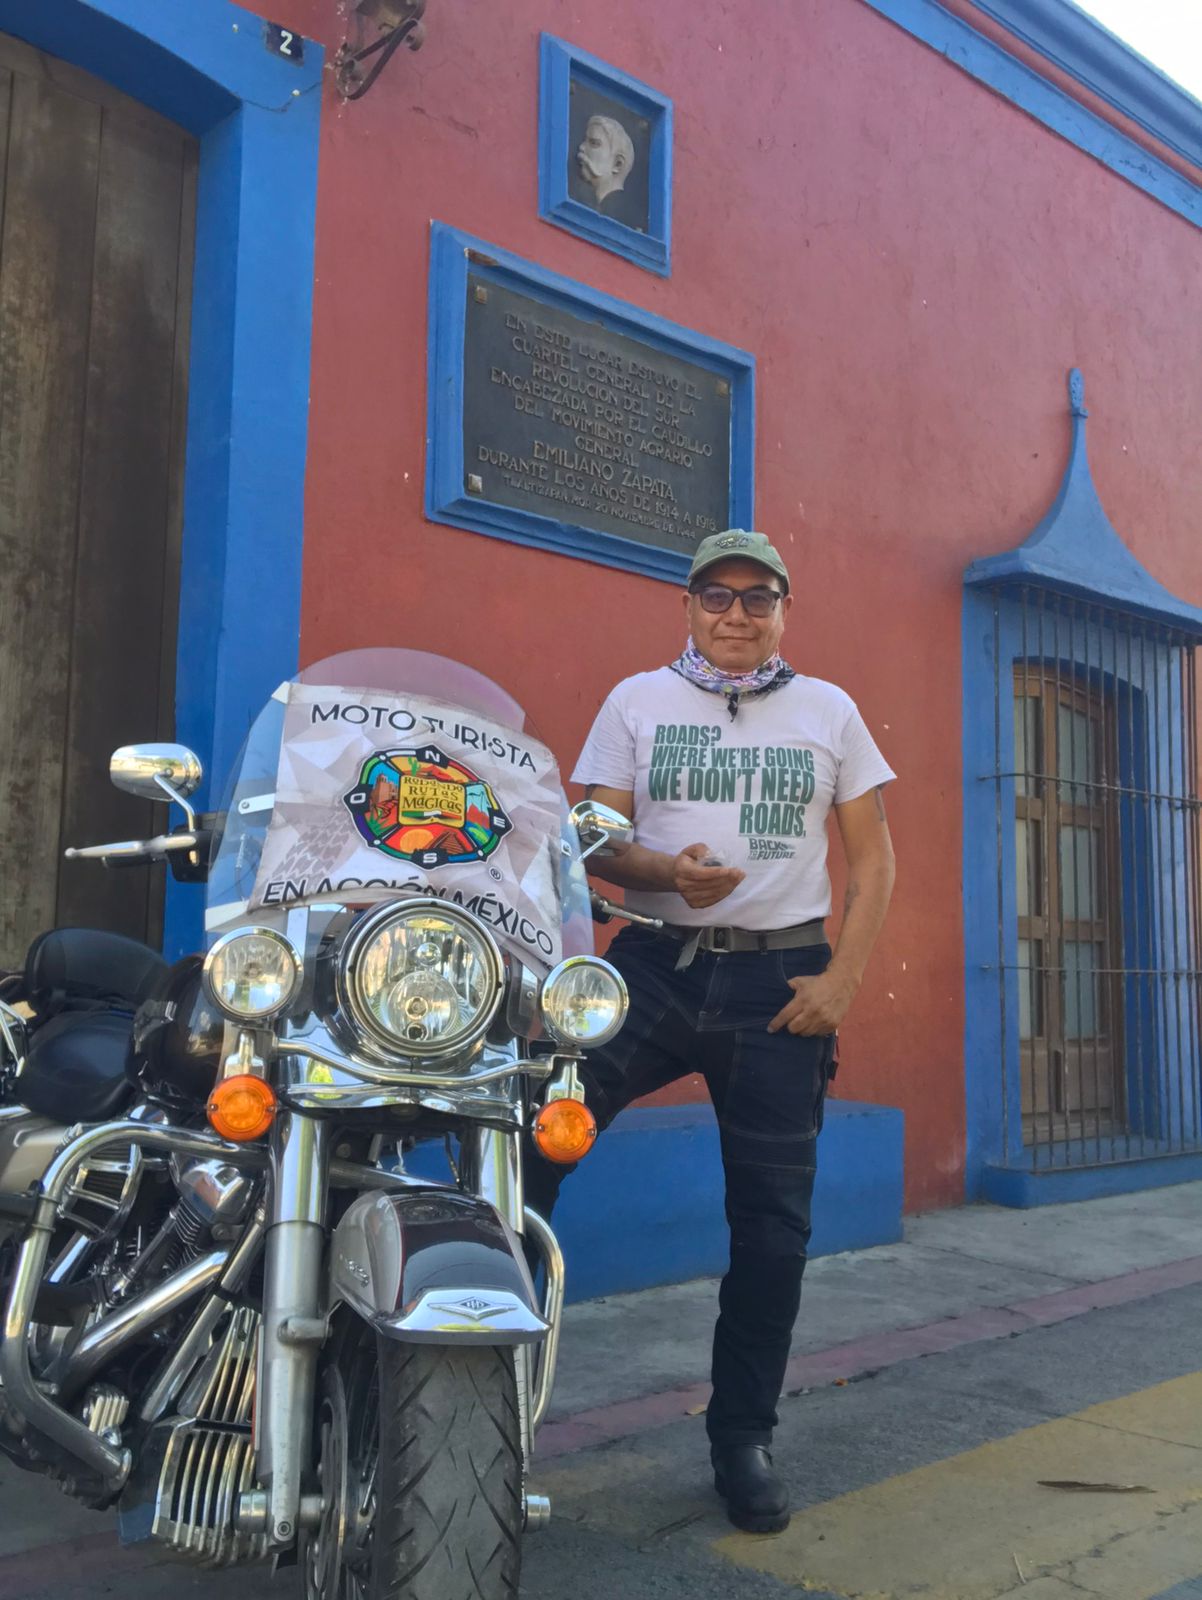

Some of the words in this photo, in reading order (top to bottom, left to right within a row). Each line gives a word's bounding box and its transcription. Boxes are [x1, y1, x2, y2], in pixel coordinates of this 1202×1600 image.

[280, 30, 293, 55] 2
[505, 314, 528, 333] EN
[534, 325, 572, 350] ESTE
[628, 361, 679, 390] ESTUVO
[685, 383, 702, 399] EL
[512, 336, 579, 373] CUARTEL
[586, 365, 650, 398] GENERAL
[656, 390, 674, 408] DE
[680, 398, 696, 416] LA
[532, 361, 618, 405] REVOLUCION
[623, 396, 648, 416] DEL
[655, 407, 680, 428] SUR
[491, 366, 588, 414] ENCABEZADA
[595, 404, 624, 426] POR
[628, 415, 647, 433] EL
[651, 425, 713, 457] CAUDILLO
[514, 394, 545, 418] DEL
[552, 407, 634, 447] MOVIMIENTO
[533, 440, 614, 481] EMILIANO
[575, 435, 640, 468] GENERAL
[478, 445, 549, 481] DURANTE
[554, 469, 586, 492] LOS
[590, 481, 628, 506] AÑOS
[632, 494, 651, 512] DE
[655, 501, 680, 520] 1914
[683, 511, 692, 525] A
[311, 703, 417, 732] MOTO
[421, 715, 538, 774] TURISTA
[654, 724, 721, 746] ROADS?
[424, 750, 441, 763] N
[651, 745, 707, 769] WHERE
[711, 747, 760, 769] WE'RE
[764, 747, 815, 773] GOING
[648, 768, 682, 802] WE
[687, 767, 756, 803] DON'T
[760, 768, 815, 805] NEED
[493, 817, 506, 828] E
[739, 802, 806, 838] ROADS.
[422, 852, 438, 863] S
[749, 838, 788, 851] BACK
[757, 851, 796, 860] FUTURE
[262, 879, 306, 904] EN
[452, 890, 553, 956] MÉXICO
